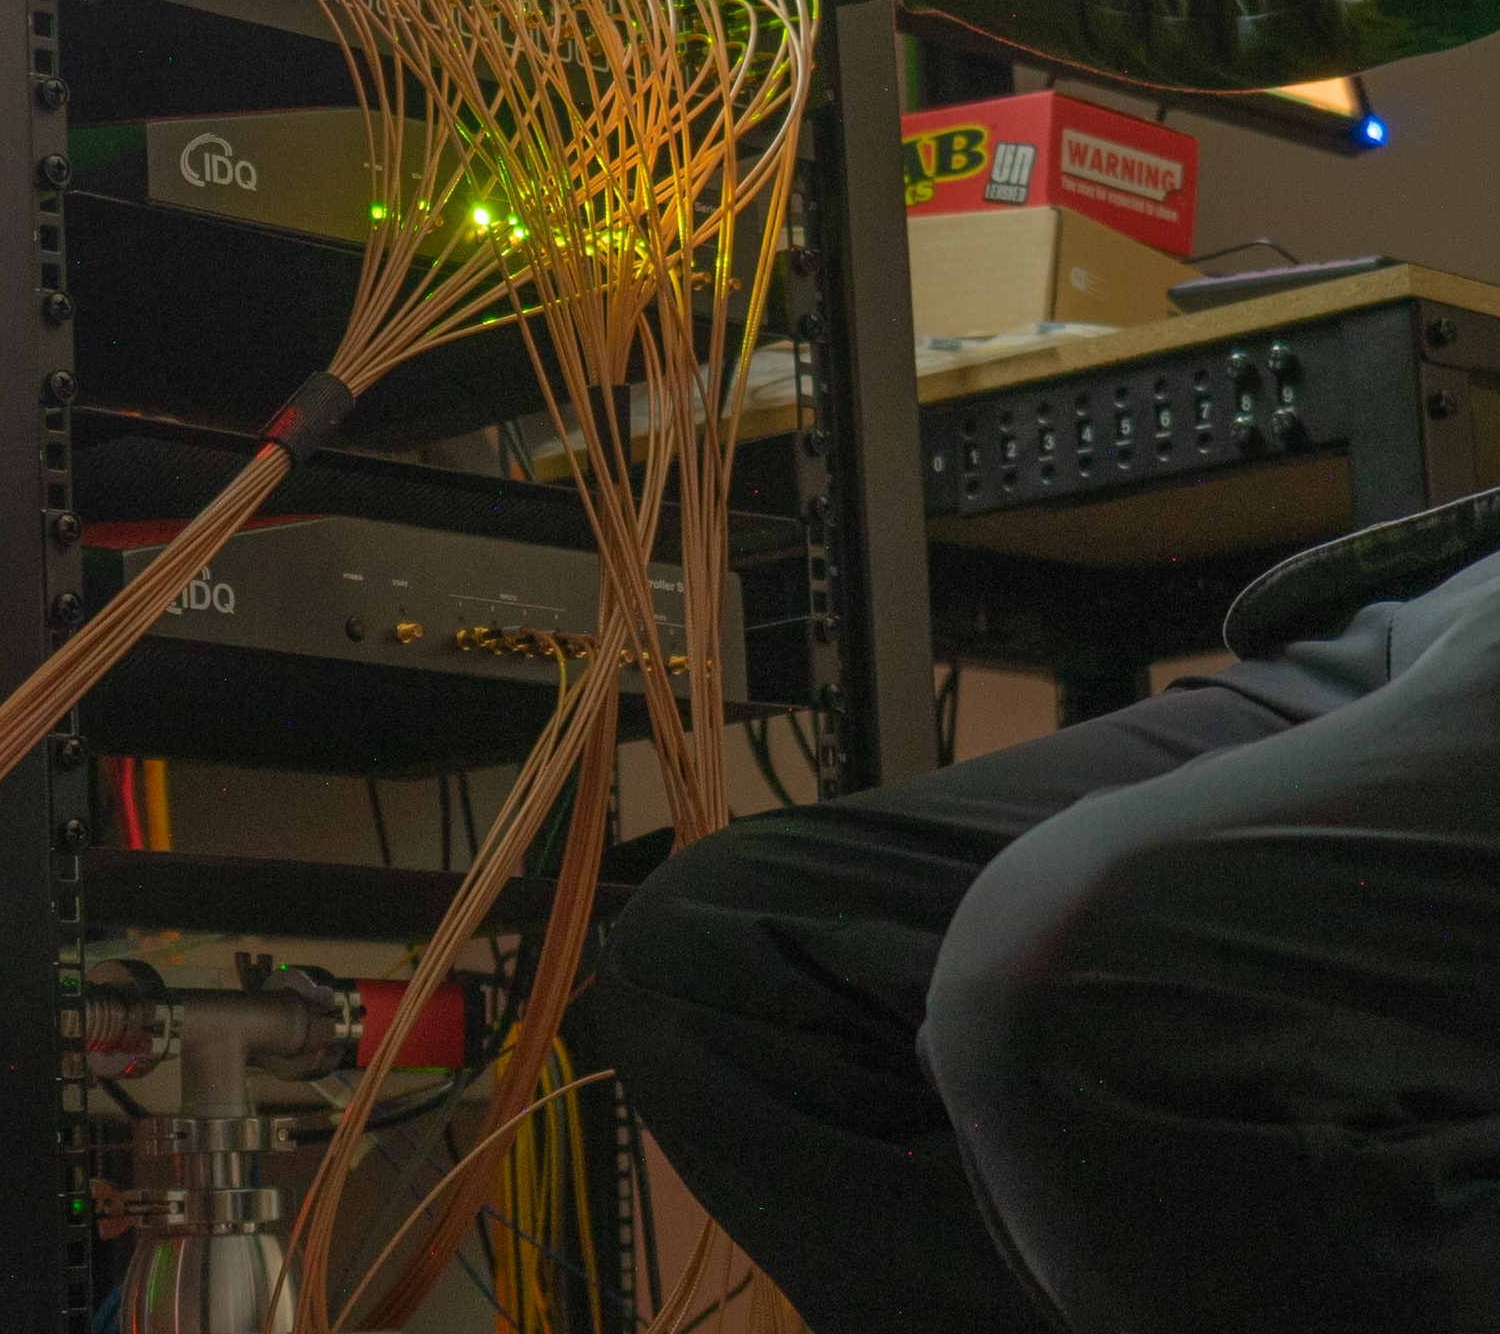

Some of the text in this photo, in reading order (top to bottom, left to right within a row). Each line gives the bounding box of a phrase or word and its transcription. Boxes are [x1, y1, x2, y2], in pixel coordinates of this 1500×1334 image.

[204, 152, 257, 192] IDQ
[1068, 139, 1175, 191] WARNING
[934, 386, 1294, 472] 0 1 2 3 4 5 6 7 8 9
